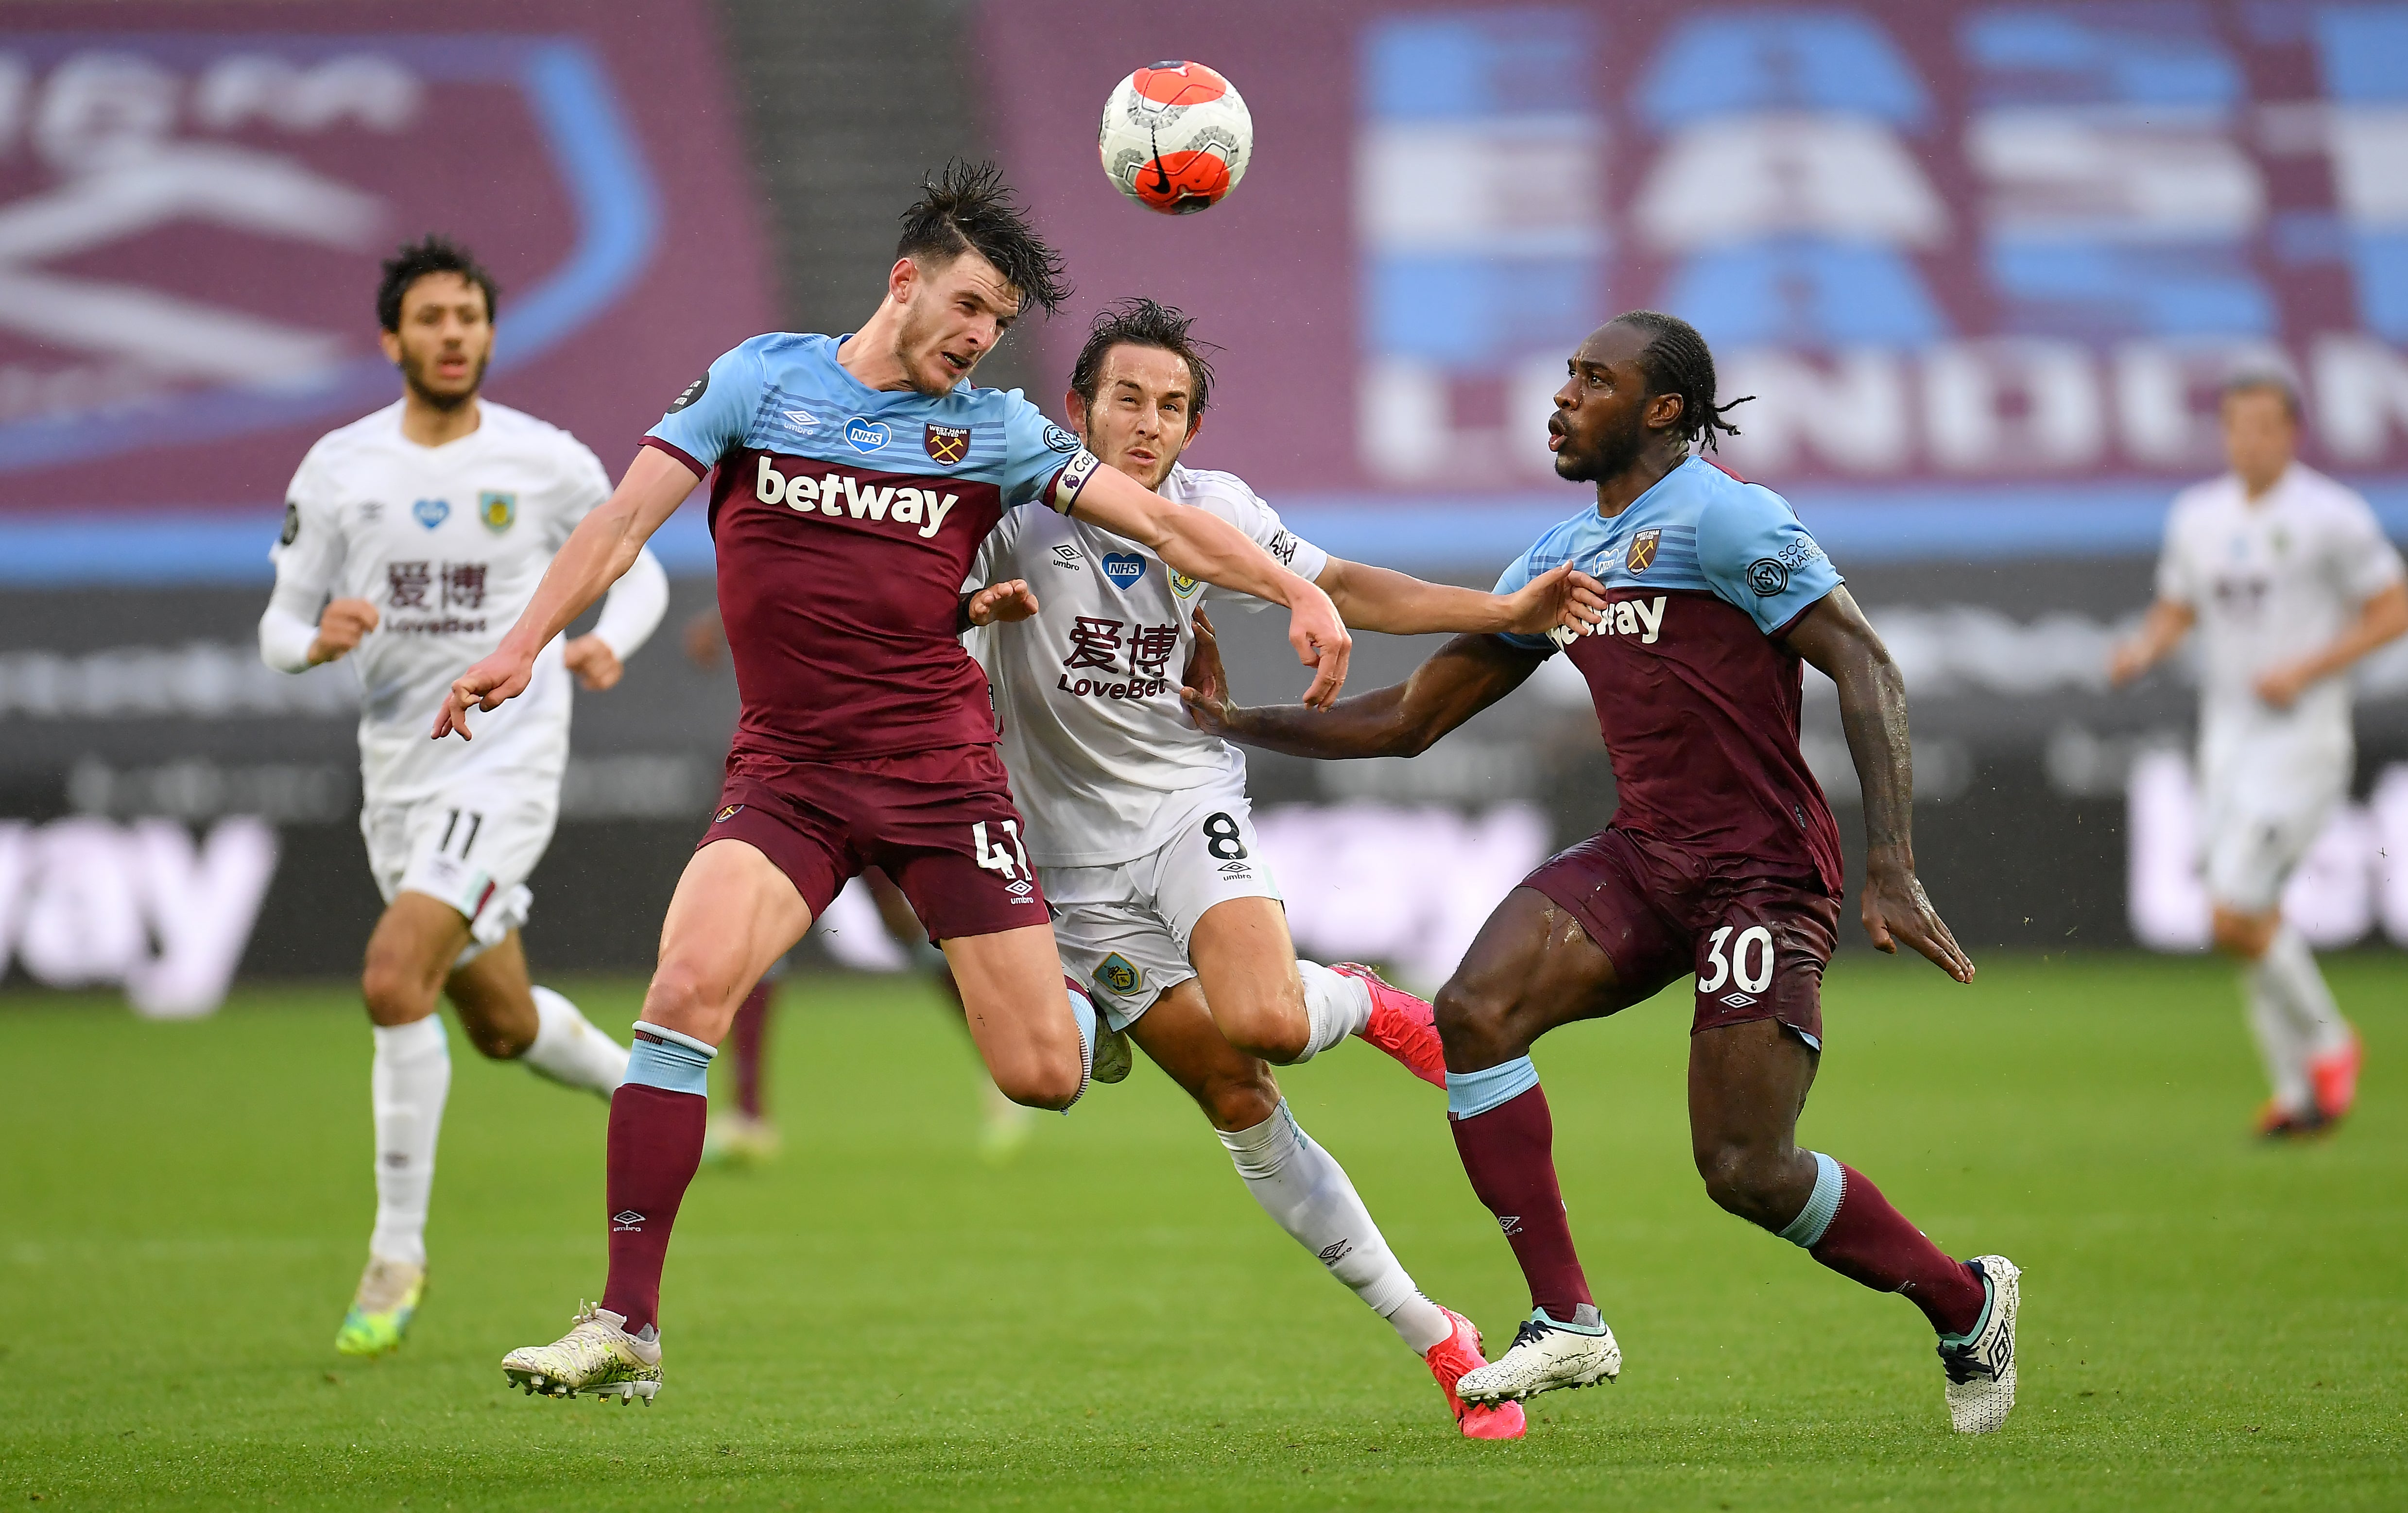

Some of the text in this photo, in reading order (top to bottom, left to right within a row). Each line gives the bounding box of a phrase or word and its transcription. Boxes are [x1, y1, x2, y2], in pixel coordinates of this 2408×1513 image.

[784, 422, 813, 435] umbro
[852, 430, 881, 443] NHS
[756, 455, 959, 538] betway
[1053, 560, 1080, 571] umbro
[1110, 564, 1138, 574] NHS
[1063, 616, 1179, 677] 爱博
[1057, 674, 1169, 699] LoveBet
[440, 808, 482, 860] 11
[972, 820, 1032, 881] 41
[1203, 812, 1248, 860] 8
[1011, 896, 1034, 905] umbro
[1698, 926, 1774, 993] 30
